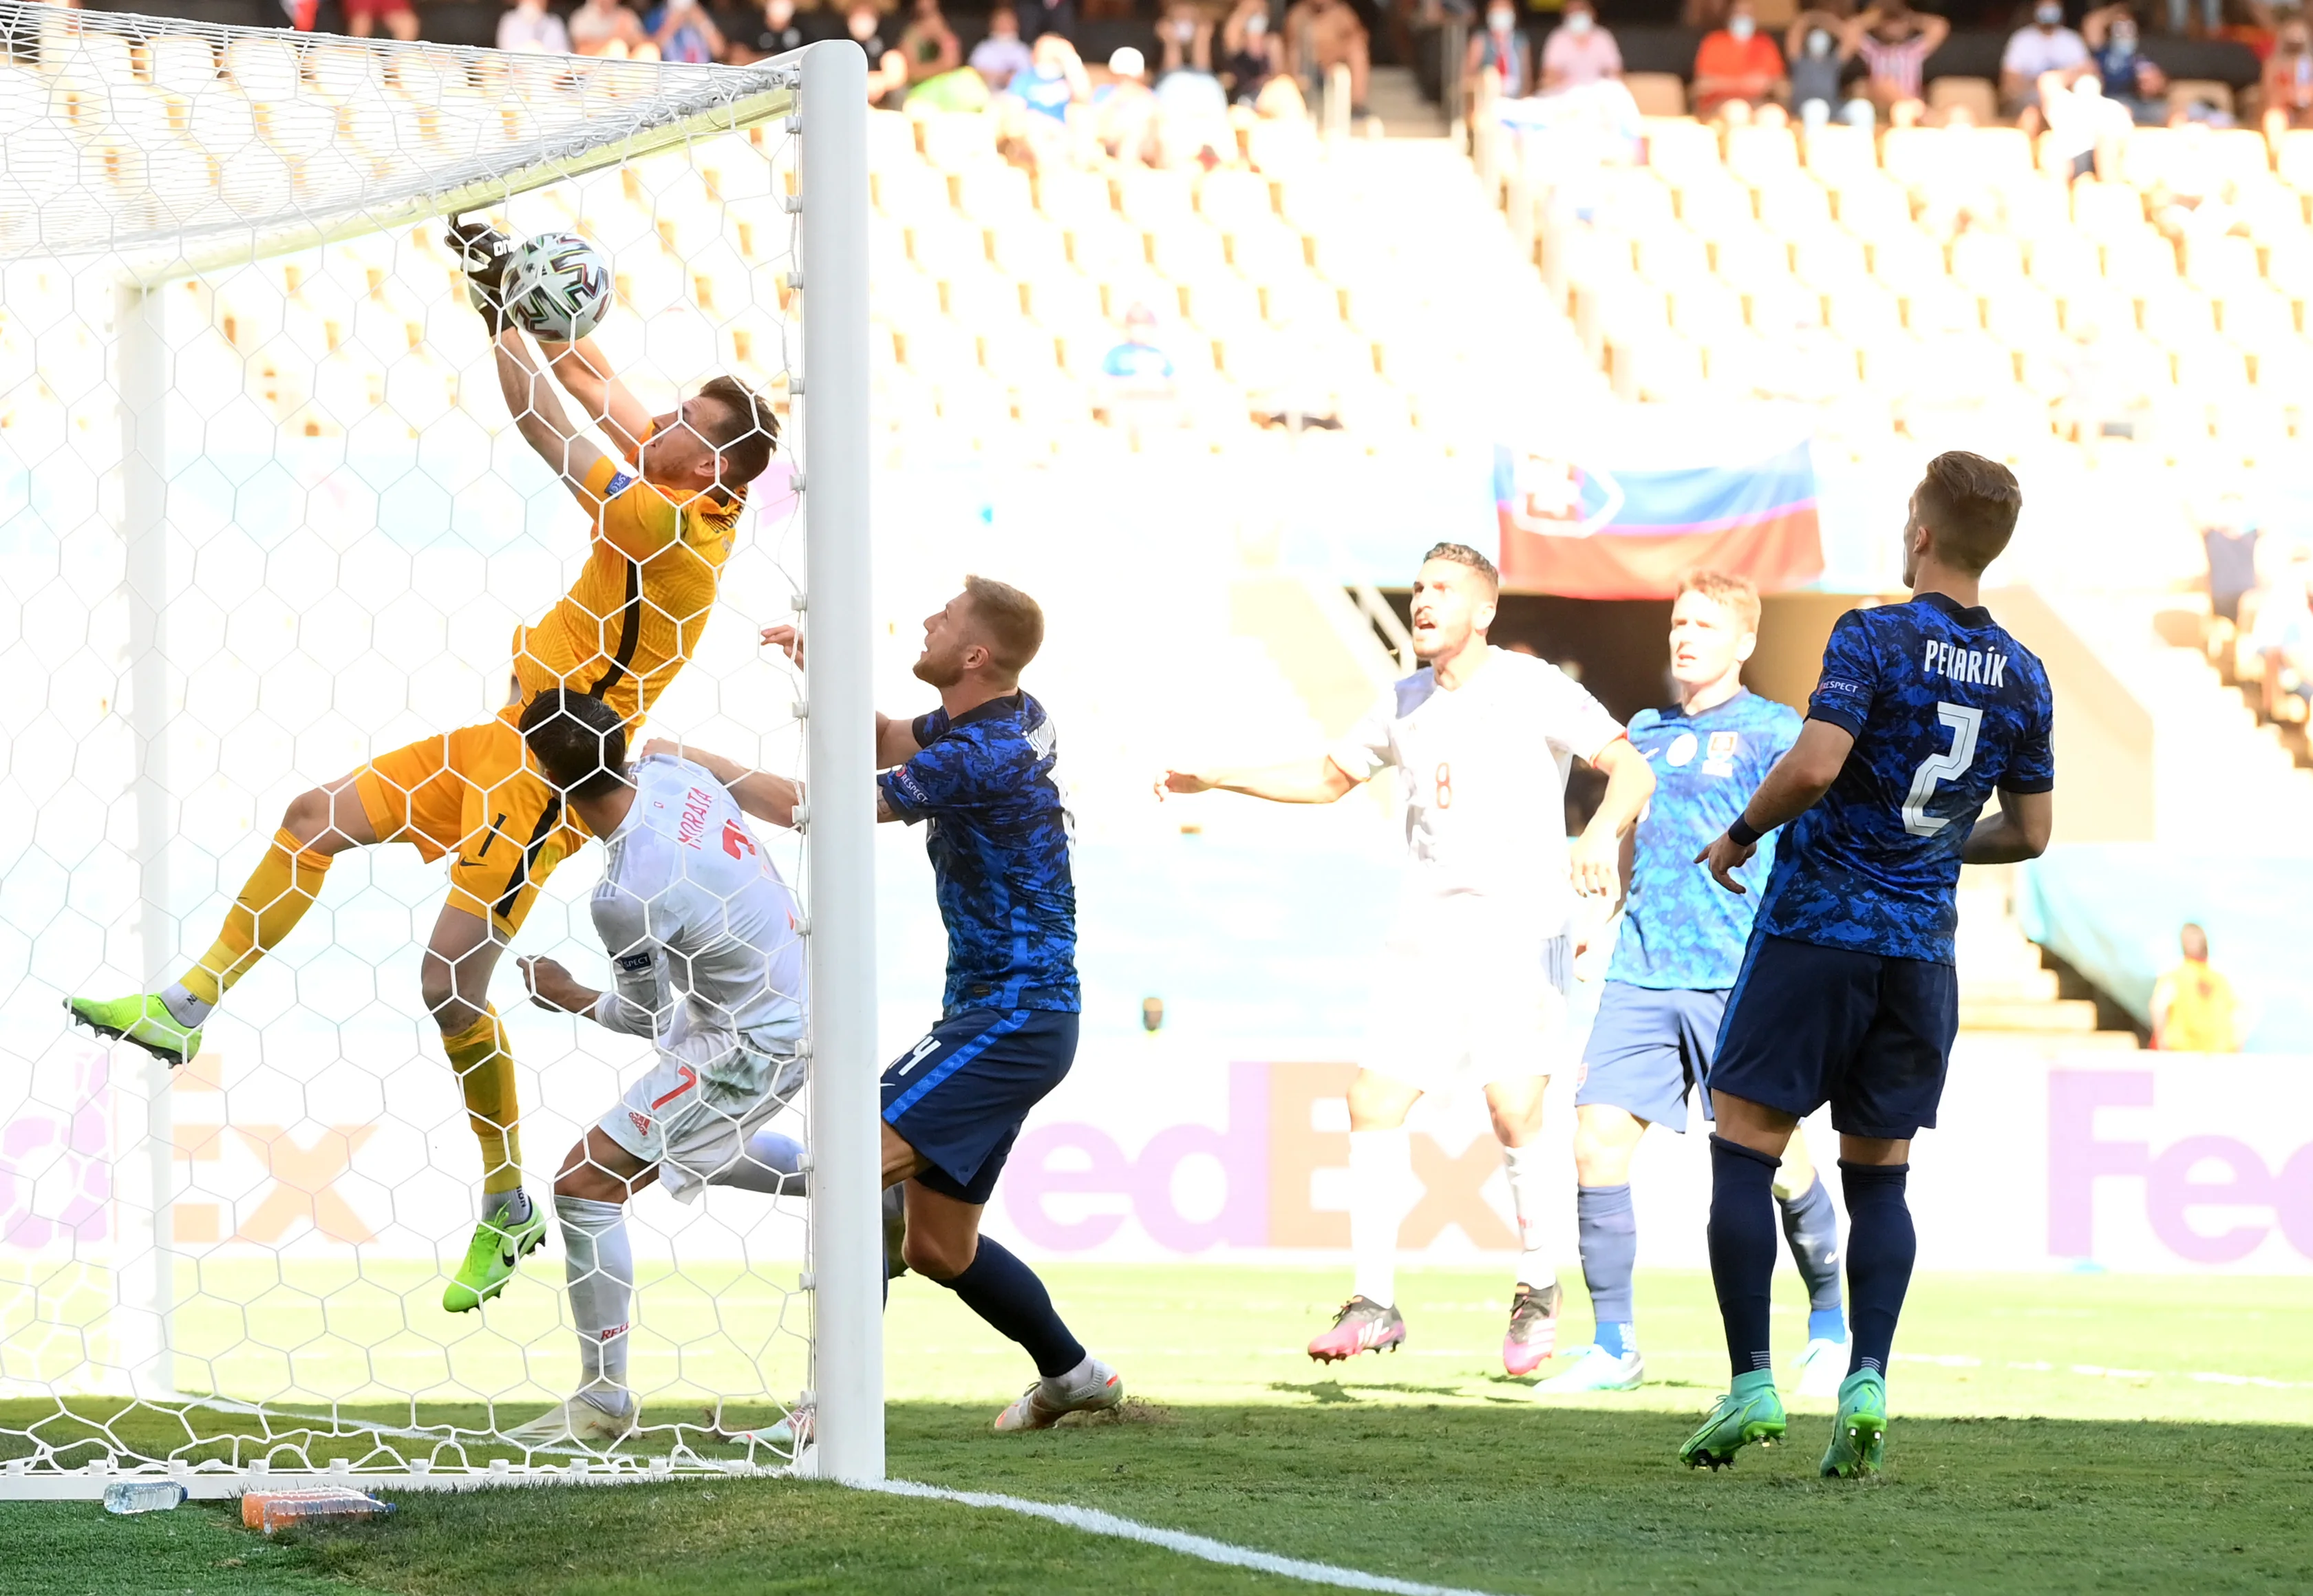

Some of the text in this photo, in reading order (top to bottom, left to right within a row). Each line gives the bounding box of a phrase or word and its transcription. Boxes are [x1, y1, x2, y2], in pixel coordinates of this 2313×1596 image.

[1924, 639, 2007, 688] PEKARÍK
[900, 774, 928, 802] RESPECT
[1436, 762, 1452, 809] 8
[1901, 701, 1983, 838] 2
[478, 812, 507, 858] 1
[677, 787, 712, 850] MORATA
[623, 956, 648, 968] SPECT
[888, 1035, 942, 1076] 4
[651, 1065, 696, 1110] 7
[628, 1111, 648, 1136] adidas
[1003, 1061, 1524, 1253] edEx
[2048, 1071, 2313, 1265] Fe
